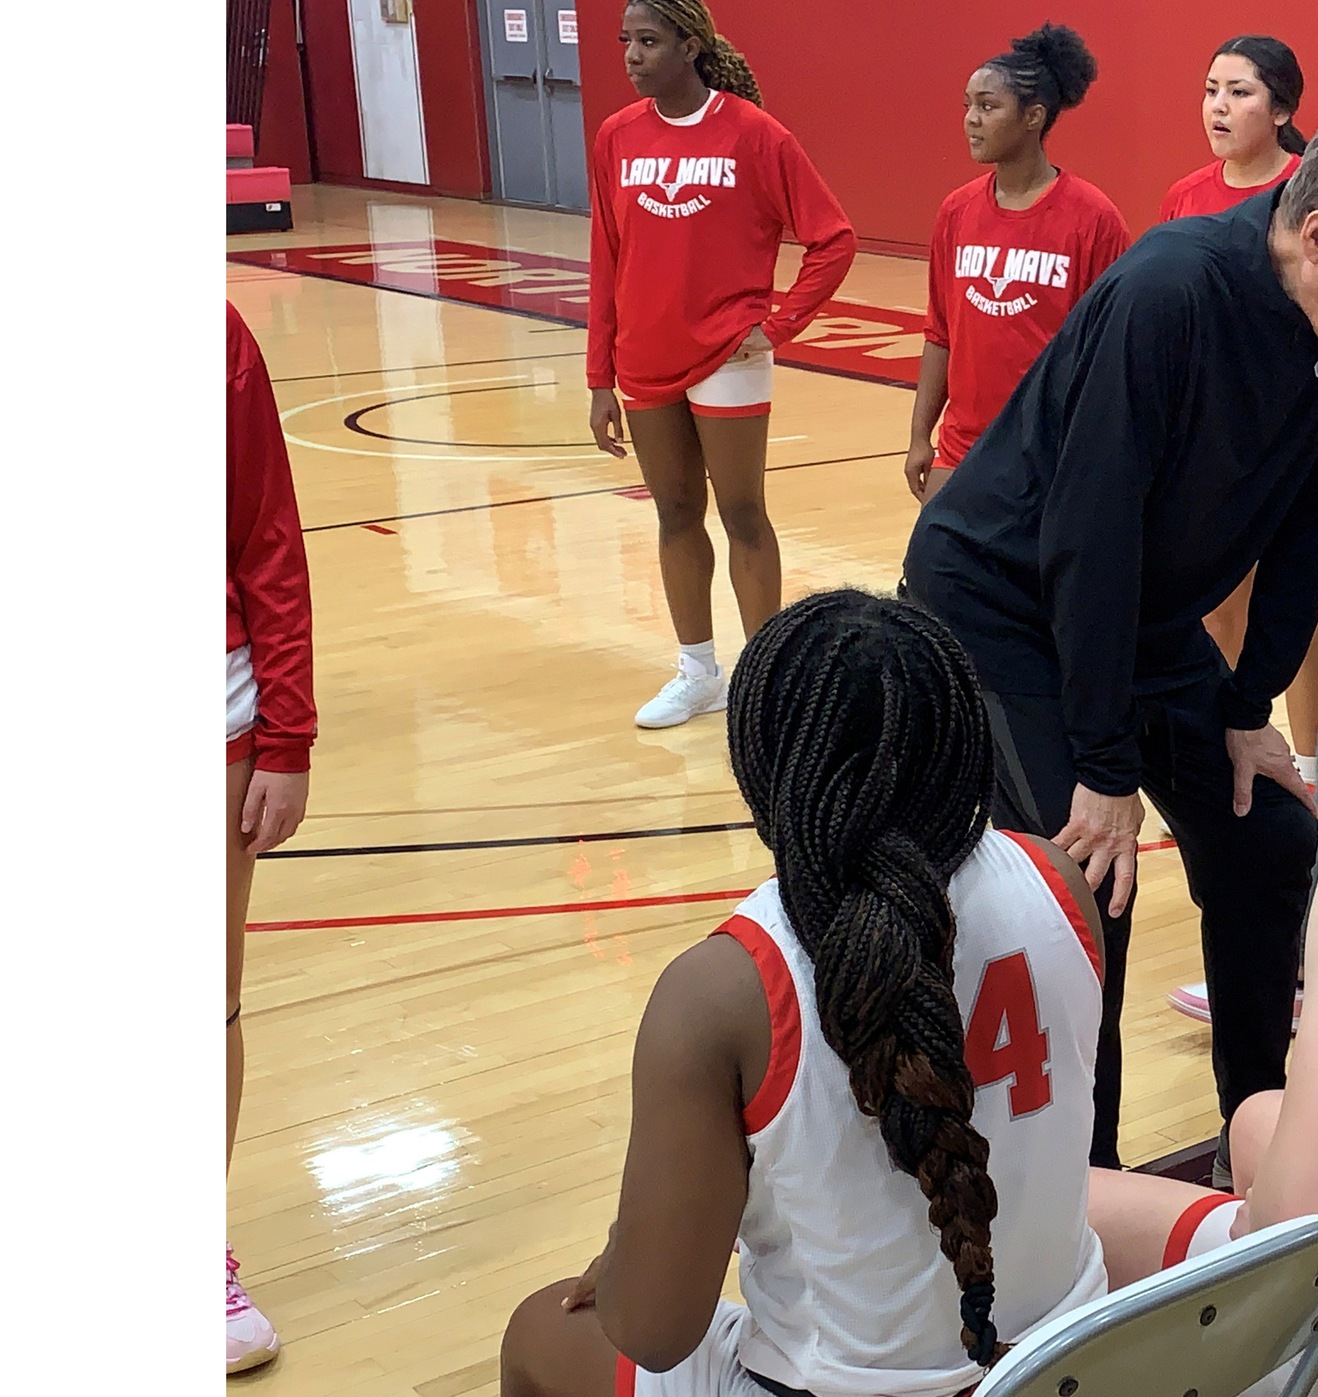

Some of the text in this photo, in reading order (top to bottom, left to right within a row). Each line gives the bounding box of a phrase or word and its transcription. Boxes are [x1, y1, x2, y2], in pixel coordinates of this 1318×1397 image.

[621, 157, 736, 188] LADY MAVS
[637, 192, 711, 218] BASKETBALL
[955, 245, 1070, 288] LADY MAVS
[965, 285, 1038, 317] BASKETBALL
[962, 947, 1054, 1123] 4
